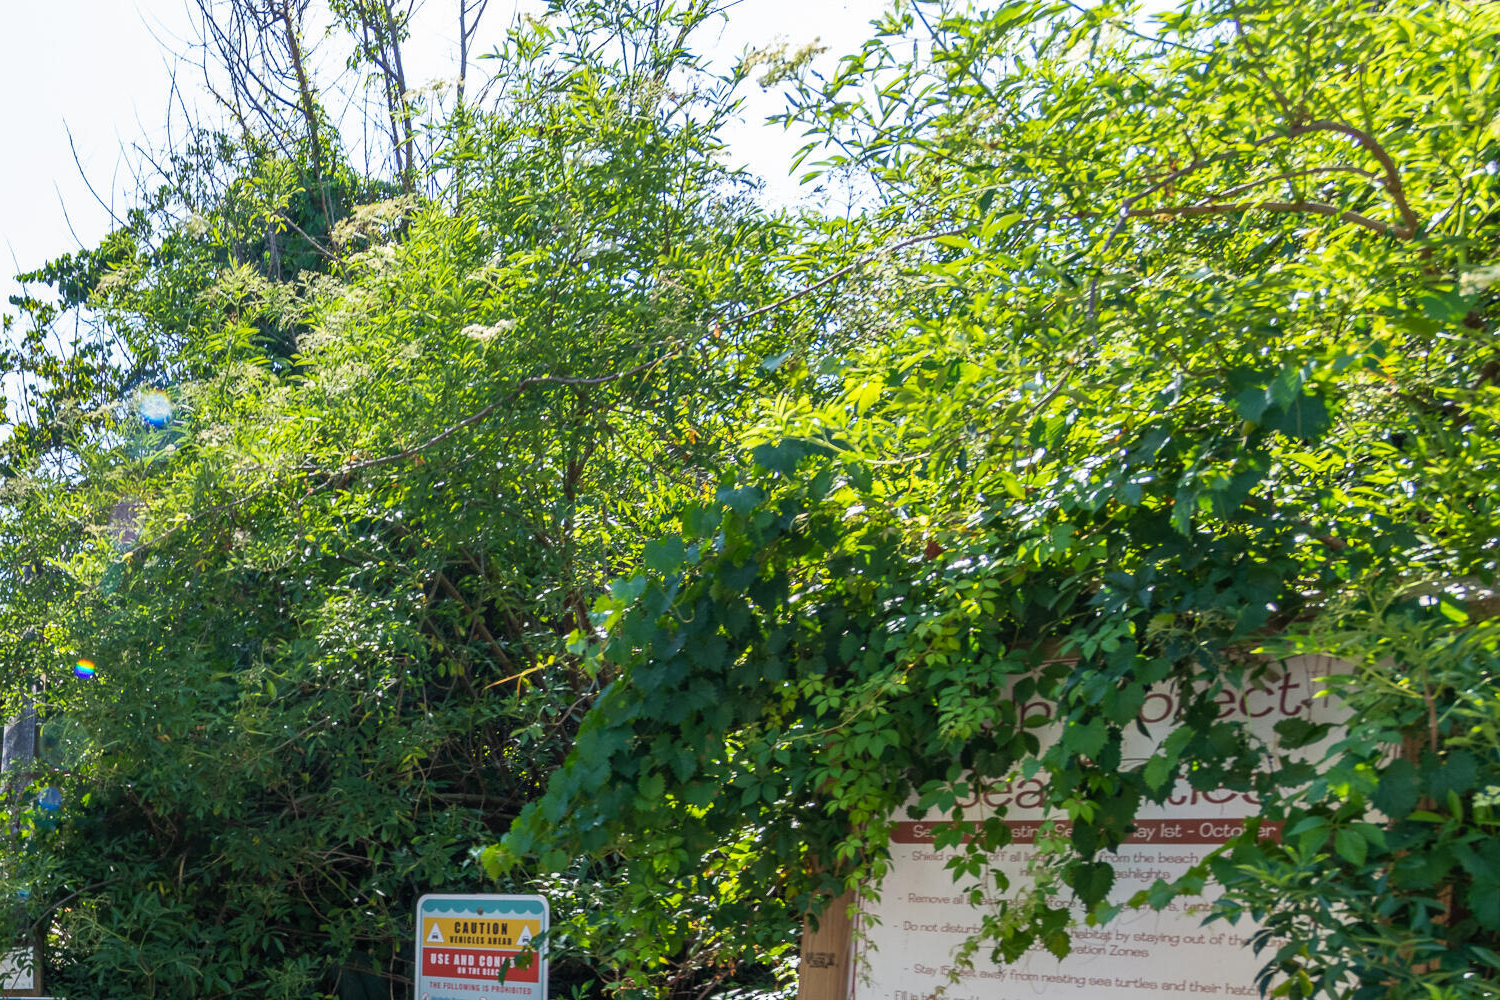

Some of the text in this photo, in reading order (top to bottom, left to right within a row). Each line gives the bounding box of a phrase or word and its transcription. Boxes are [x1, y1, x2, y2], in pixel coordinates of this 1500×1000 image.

[1133, 825, 1156, 841] ay
[1200, 822, 1277, 838] Octoer
[1133, 852, 1154, 863] the
[1158, 852, 1198, 864] beach
[1114, 868, 1171, 882] ashlights
[908, 893, 950, 904] Remove
[953, 894, 964, 904] all
[454, 922, 508, 935] CAUTION
[903, 921, 918, 931] Do
[920, 924, 937, 932] not
[941, 922, 981, 934] disturb
[1116, 929, 1130, 943] by
[1133, 933, 1180, 947] staying
[1183, 935, 1205, 945] out
[1209, 934, 1225, 945] of
[450, 936, 512, 945] VEHICLES AHEAD
[1110, 945, 1149, 957] Zones
[430, 953, 450, 965] USE
[454, 954, 475, 966] AND
[914, 964, 937, 977] Stay
[1010, 969, 1039, 982] from
[1041, 974, 1086, 988] nesting
[1088, 978, 1112, 987] sea
[1115, 977, 1158, 990] turtles
[1161, 980, 1186, 991] and
[1189, 980, 1221, 993] their
[429, 981, 441, 989] THE
[443, 983, 480, 992] FOLLOWING
[491, 985, 532, 995] PROHIBITED
